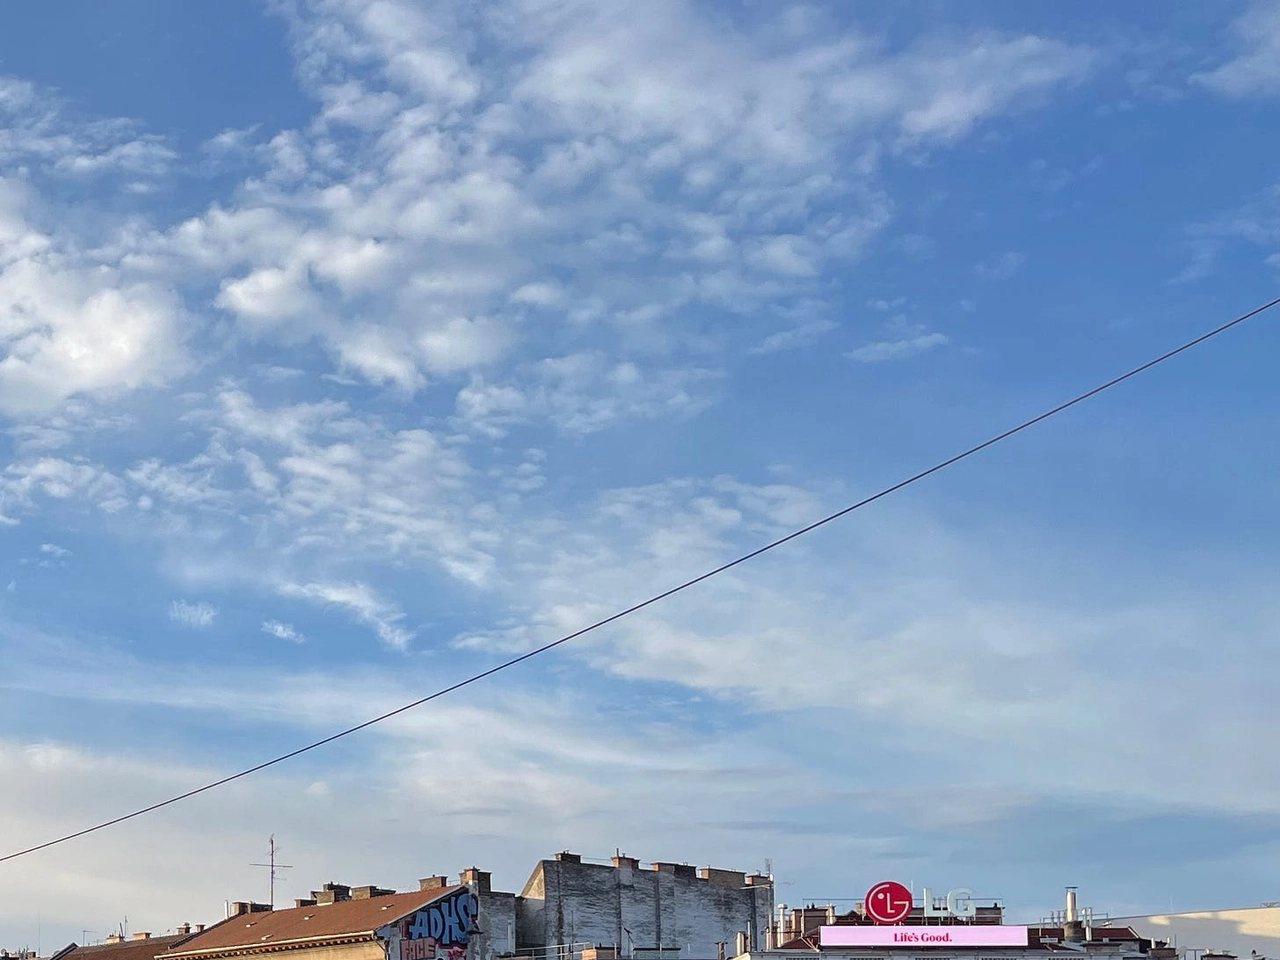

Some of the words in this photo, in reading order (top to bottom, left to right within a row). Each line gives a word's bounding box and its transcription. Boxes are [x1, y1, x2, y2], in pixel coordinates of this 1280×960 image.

[923, 887, 976, 918] LG
[893, 932, 920, 943] Life's
[921, 932, 953, 943] Good.
